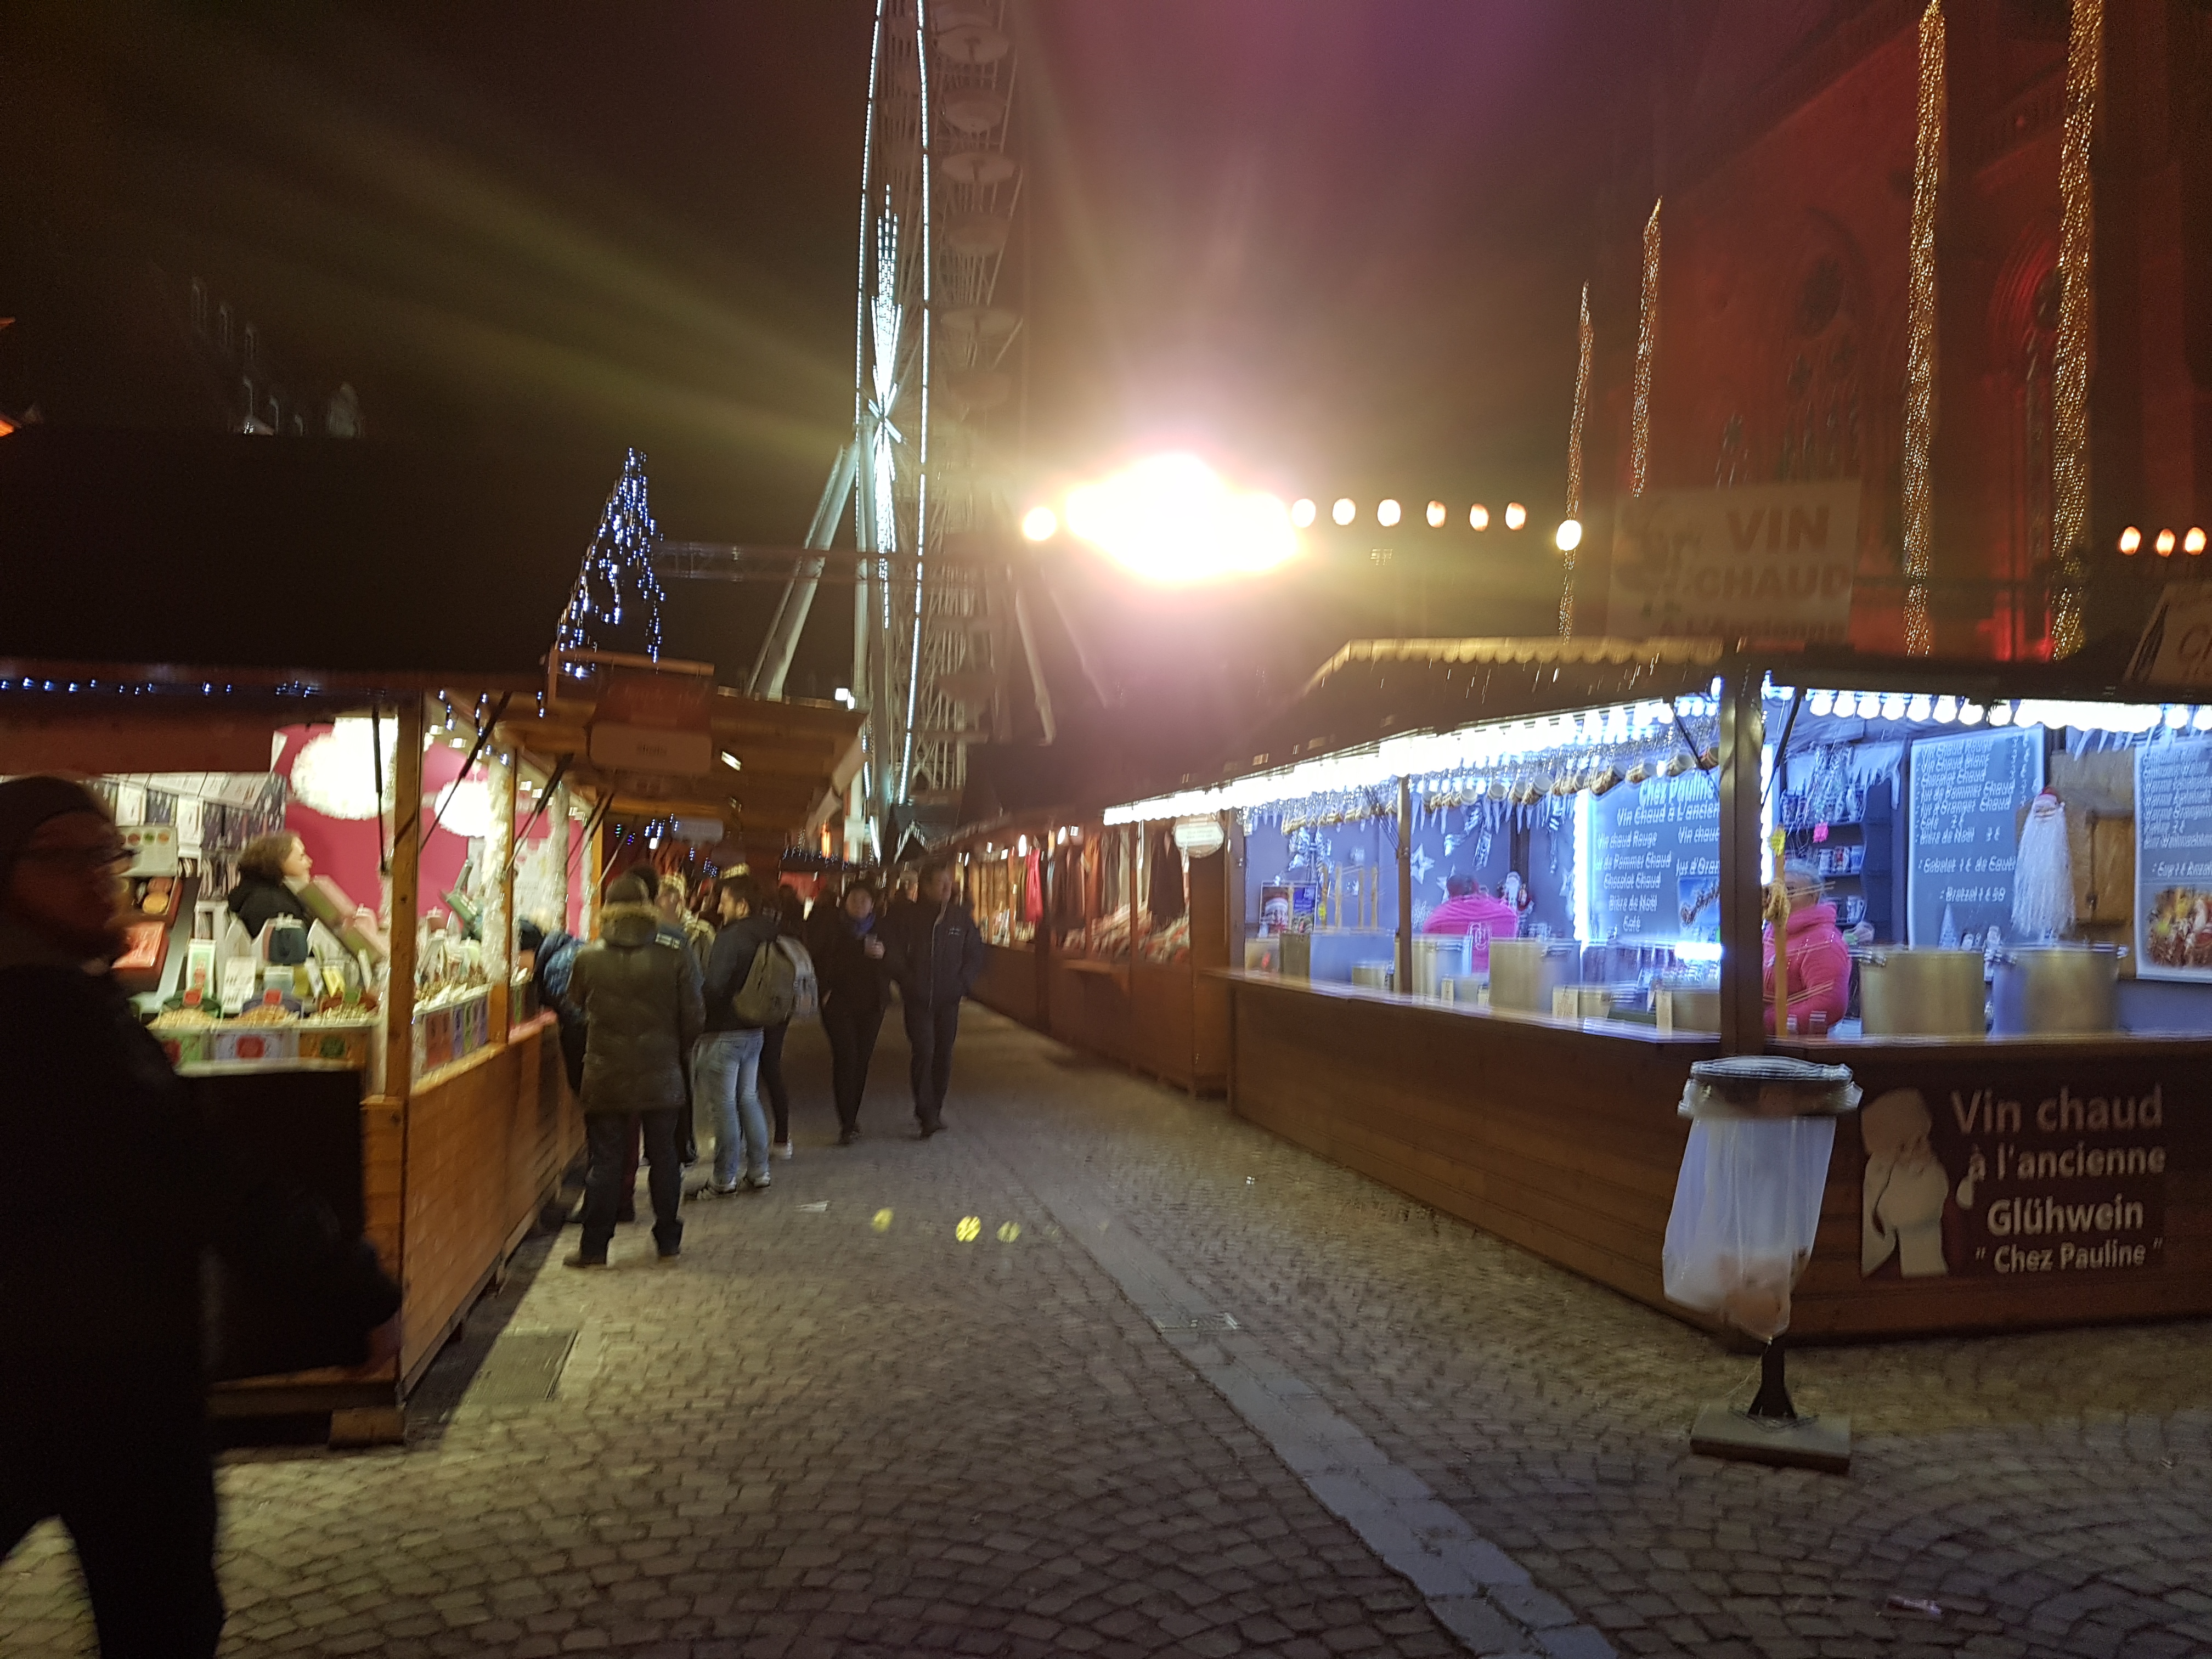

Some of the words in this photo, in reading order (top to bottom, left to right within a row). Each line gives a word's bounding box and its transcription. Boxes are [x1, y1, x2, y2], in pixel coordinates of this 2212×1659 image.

[1725, 504, 1830, 553] VIN
[1694, 565, 1851, 600] CHAUD
[1639, 777, 1668, 808] Chez
[1668, 771, 1716, 803] Pauline
[1617, 808, 1633, 827] Vin
[1634, 804, 1666, 825] Chaud
[1668, 804, 1675, 822] à
[1597, 832, 1609, 850] Vin
[1633, 830, 1657, 849] Rouge
[1678, 826, 1692, 844] Vin
[1613, 854, 1644, 870] Pommes
[1645, 850, 1672, 869] Chaud
[1675, 859, 1689, 877] Jus
[1603, 872, 1635, 889] Chocolat
[1635, 871, 1661, 889] Chaud
[1609, 895, 1628, 912] Bière
[1628, 894, 1638, 911] de
[1639, 894, 1657, 911] Noël
[1623, 915, 1641, 932] Café
[1950, 1087, 2022, 1134] Vin
[2036, 1082, 2163, 1133] chaud
[1997, 1141, 2166, 1180] l'ancienne
[1987, 1192, 2144, 1237] Glühwein
[1994, 1244, 2053, 1273] Chez
[2060, 1238, 2146, 1270] Pauline
